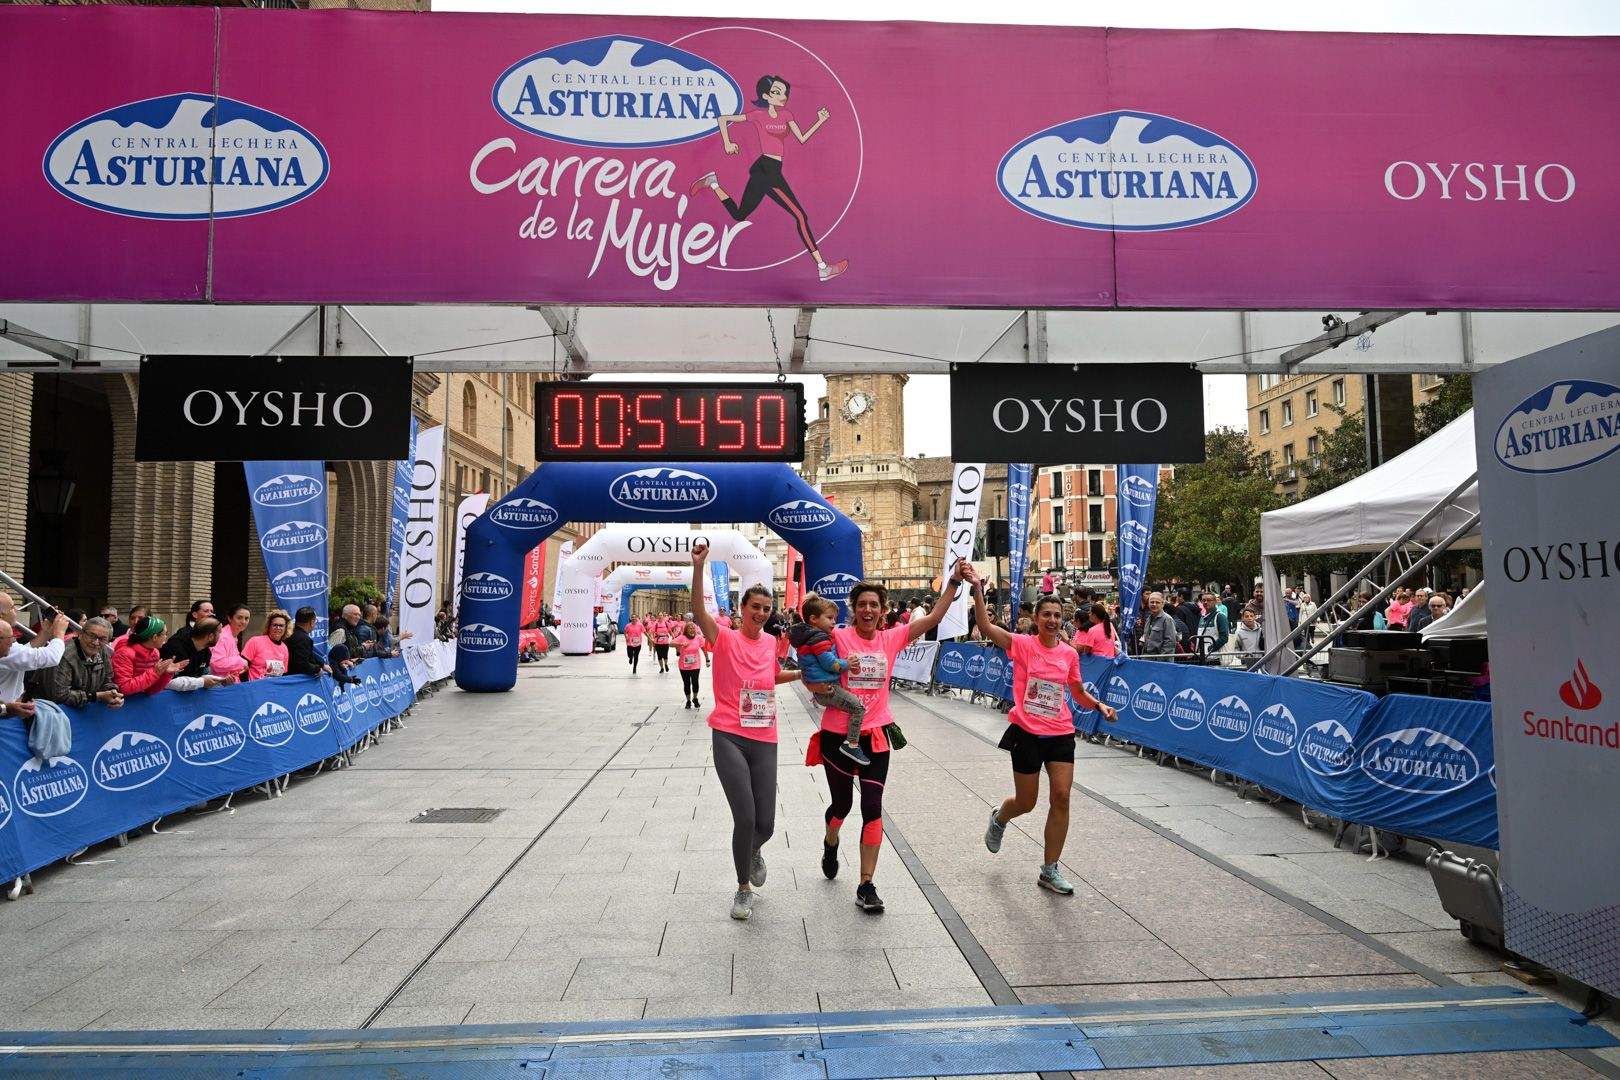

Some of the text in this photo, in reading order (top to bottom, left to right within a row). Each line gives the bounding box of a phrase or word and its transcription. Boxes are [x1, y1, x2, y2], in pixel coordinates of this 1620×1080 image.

[551, 73, 716, 87] CENTRAL LECHERA
[512, 74, 722, 120] ASTURIANA
[111, 137, 299, 150] CENTRAL LECHERA
[1057, 152, 1229, 165] CENTRAL LECHERA
[65, 139, 307, 187] ASTURIANA
[469, 137, 677, 199] Carrera
[1017, 154, 1239, 200] ASTURIANA
[1384, 160, 1576, 203] OYSHO
[518, 194, 753, 291] de la Mujer
[183, 389, 373, 428] OYSHO
[992, 397, 1168, 433] OYSHO
[1521, 399, 1620, 431] CENTRAL LECHERA
[1503, 412, 1620, 459] ASTURIANA
[617, 481, 710, 501] ASTURIANA
[1065, 475, 1073, 516] HOTEL
[493, 508, 553, 523] ASTURIANA
[774, 512, 831, 524] ASTURIANA
[405, 460, 437, 609] OYSHO
[948, 465, 981, 602] YSHO
[1503, 541, 1620, 582] OYSH
[464, 582, 509, 595] ASTURIANA
[460, 633, 504, 646] ASTURIANA
[299, 709, 329, 727] ASTURIANA
[1133, 697, 1164, 714] ASTURIANA
[1169, 703, 1202, 722] ASTURIANA
[1209, 709, 1248, 732] ASTURIANA
[184, 732, 243, 758] ASTURIANA
[255, 719, 293, 740] ASTURIANA
[1523, 710, 1620, 750] Santand
[100, 750, 168, 783] ASTURIANA
[1366, 747, 1468, 782] ASTURIANA
[21, 774, 85, 806] ASTURIANA
